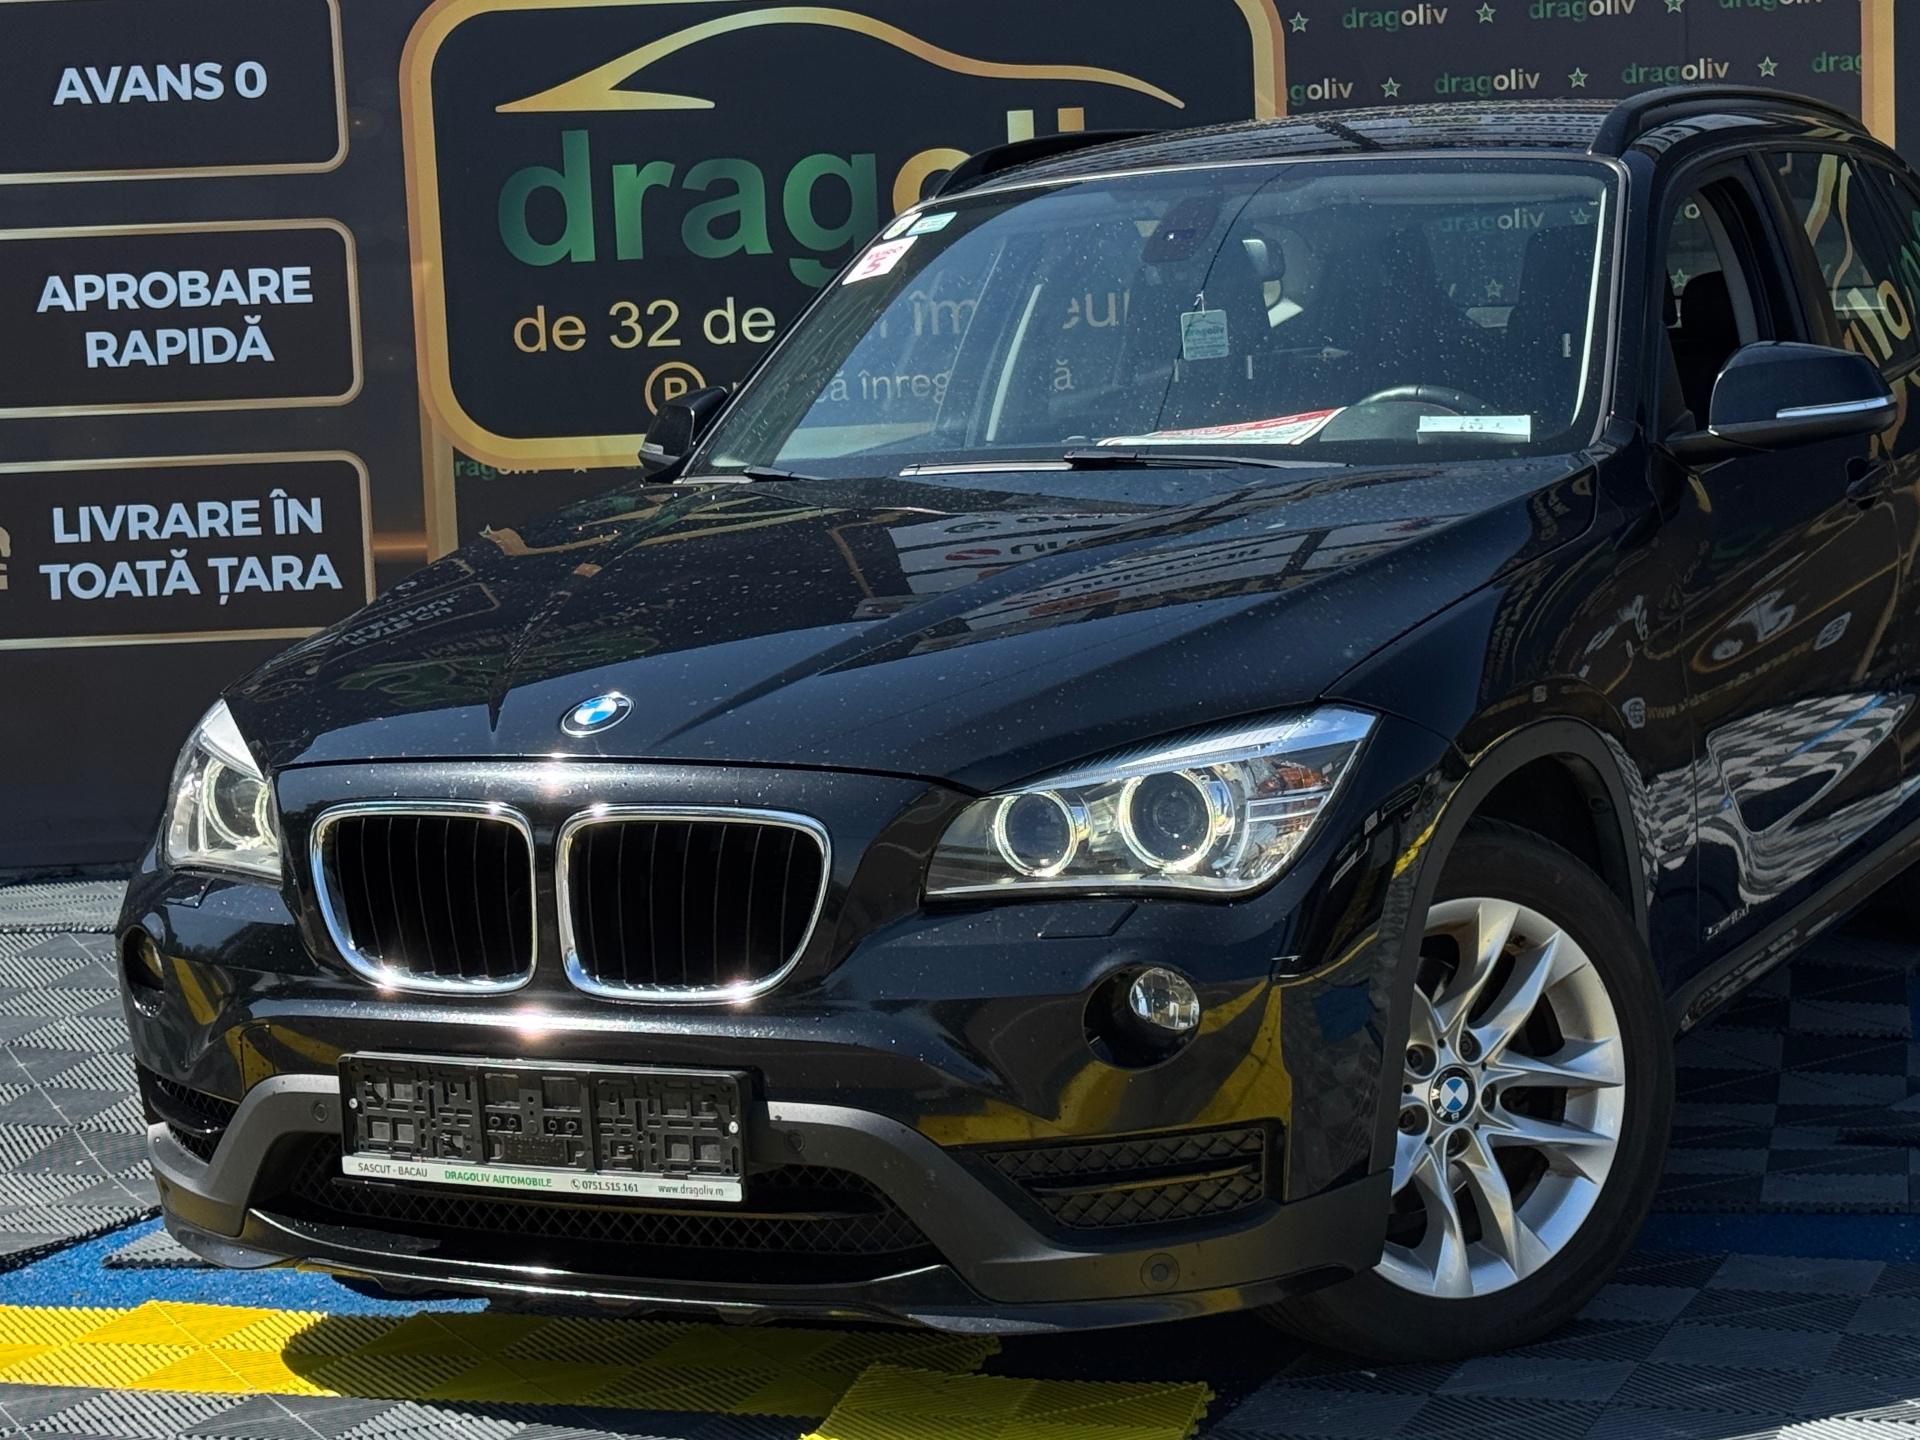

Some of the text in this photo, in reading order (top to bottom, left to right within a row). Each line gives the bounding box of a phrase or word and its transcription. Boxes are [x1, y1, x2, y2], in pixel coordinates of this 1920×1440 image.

[1342, 4, 1448, 32] dragoliv
[1529, 0, 1635, 22] dragoliv
[53, 61, 268, 105] AVANS 0
[1434, 69, 1540, 96] dragoliv
[1622, 58, 1729, 86] dragoliv
[1287, 78, 1353, 106] goliv
[37, 266, 313, 313] APROBARE
[85, 315, 275, 368] RAPIDĂ
[514, 297, 777, 352] de 32 de
[53, 489, 323, 544] LIVRARE ÎN
[40, 549, 343, 604] TOATĂ ȚARA
[358, 1163, 392, 1174] SASCUT
[398, 1164, 428, 1177] BACAU
[444, 1170, 490, 1183] DRAGOLIV
[492, 1173, 552, 1187] AUTOMOBILE
